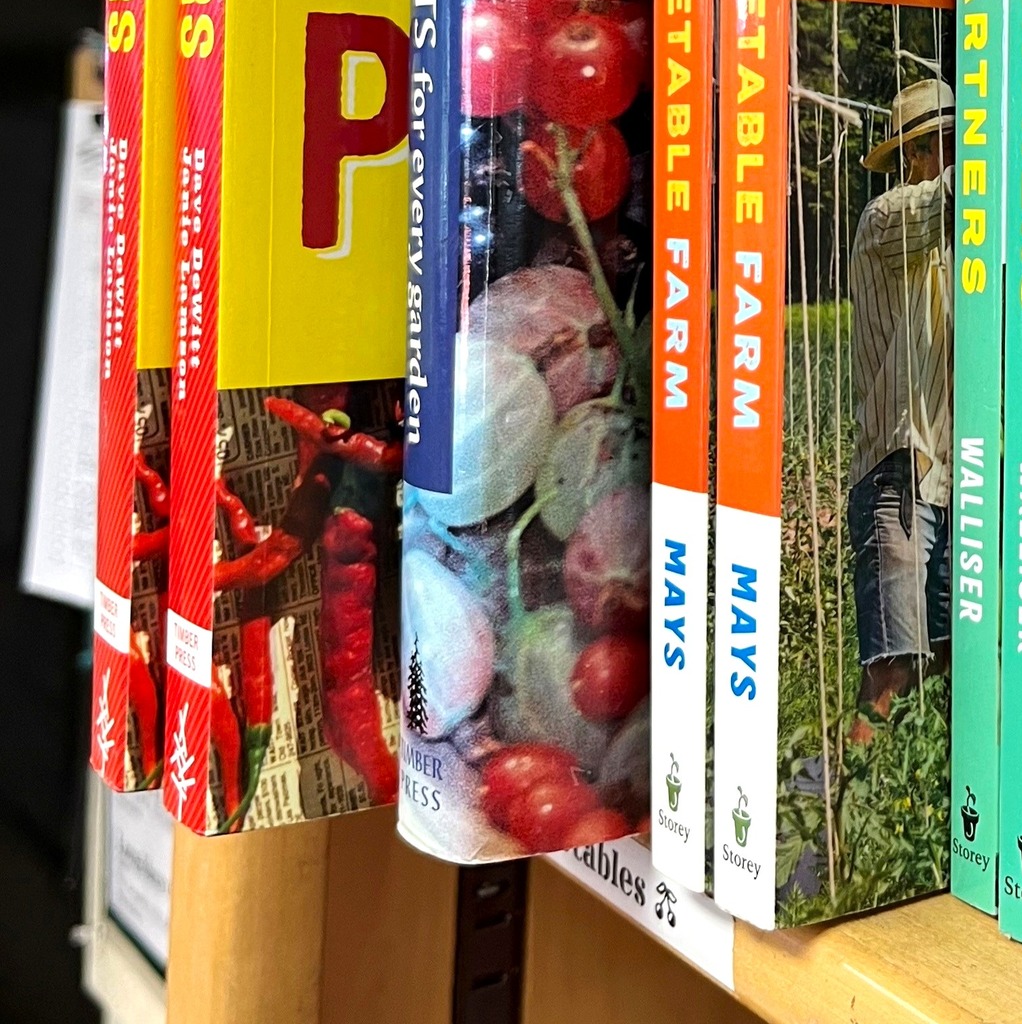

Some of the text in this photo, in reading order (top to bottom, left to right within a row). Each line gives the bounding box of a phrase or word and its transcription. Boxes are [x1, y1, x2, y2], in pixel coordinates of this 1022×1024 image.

[410, 67, 433, 141] for
[190, 146, 205, 368] Dave DeWitt
[407, 148, 425, 275] every
[406, 283, 429, 445] garden
[665, 237, 689, 410] FARM
[732, 249, 762, 429] FARM
[958, 437, 985, 623] WALLISER
[174, 622, 198, 650] TIMBER
[175, 645, 196, 671] PRESS
[663, 538, 686, 671] MAYS
[729, 563, 758, 702] MAYS
[657, 809, 691, 844] Storey
[721, 843, 762, 879] Storey
[952, 838, 991, 872] Storey
